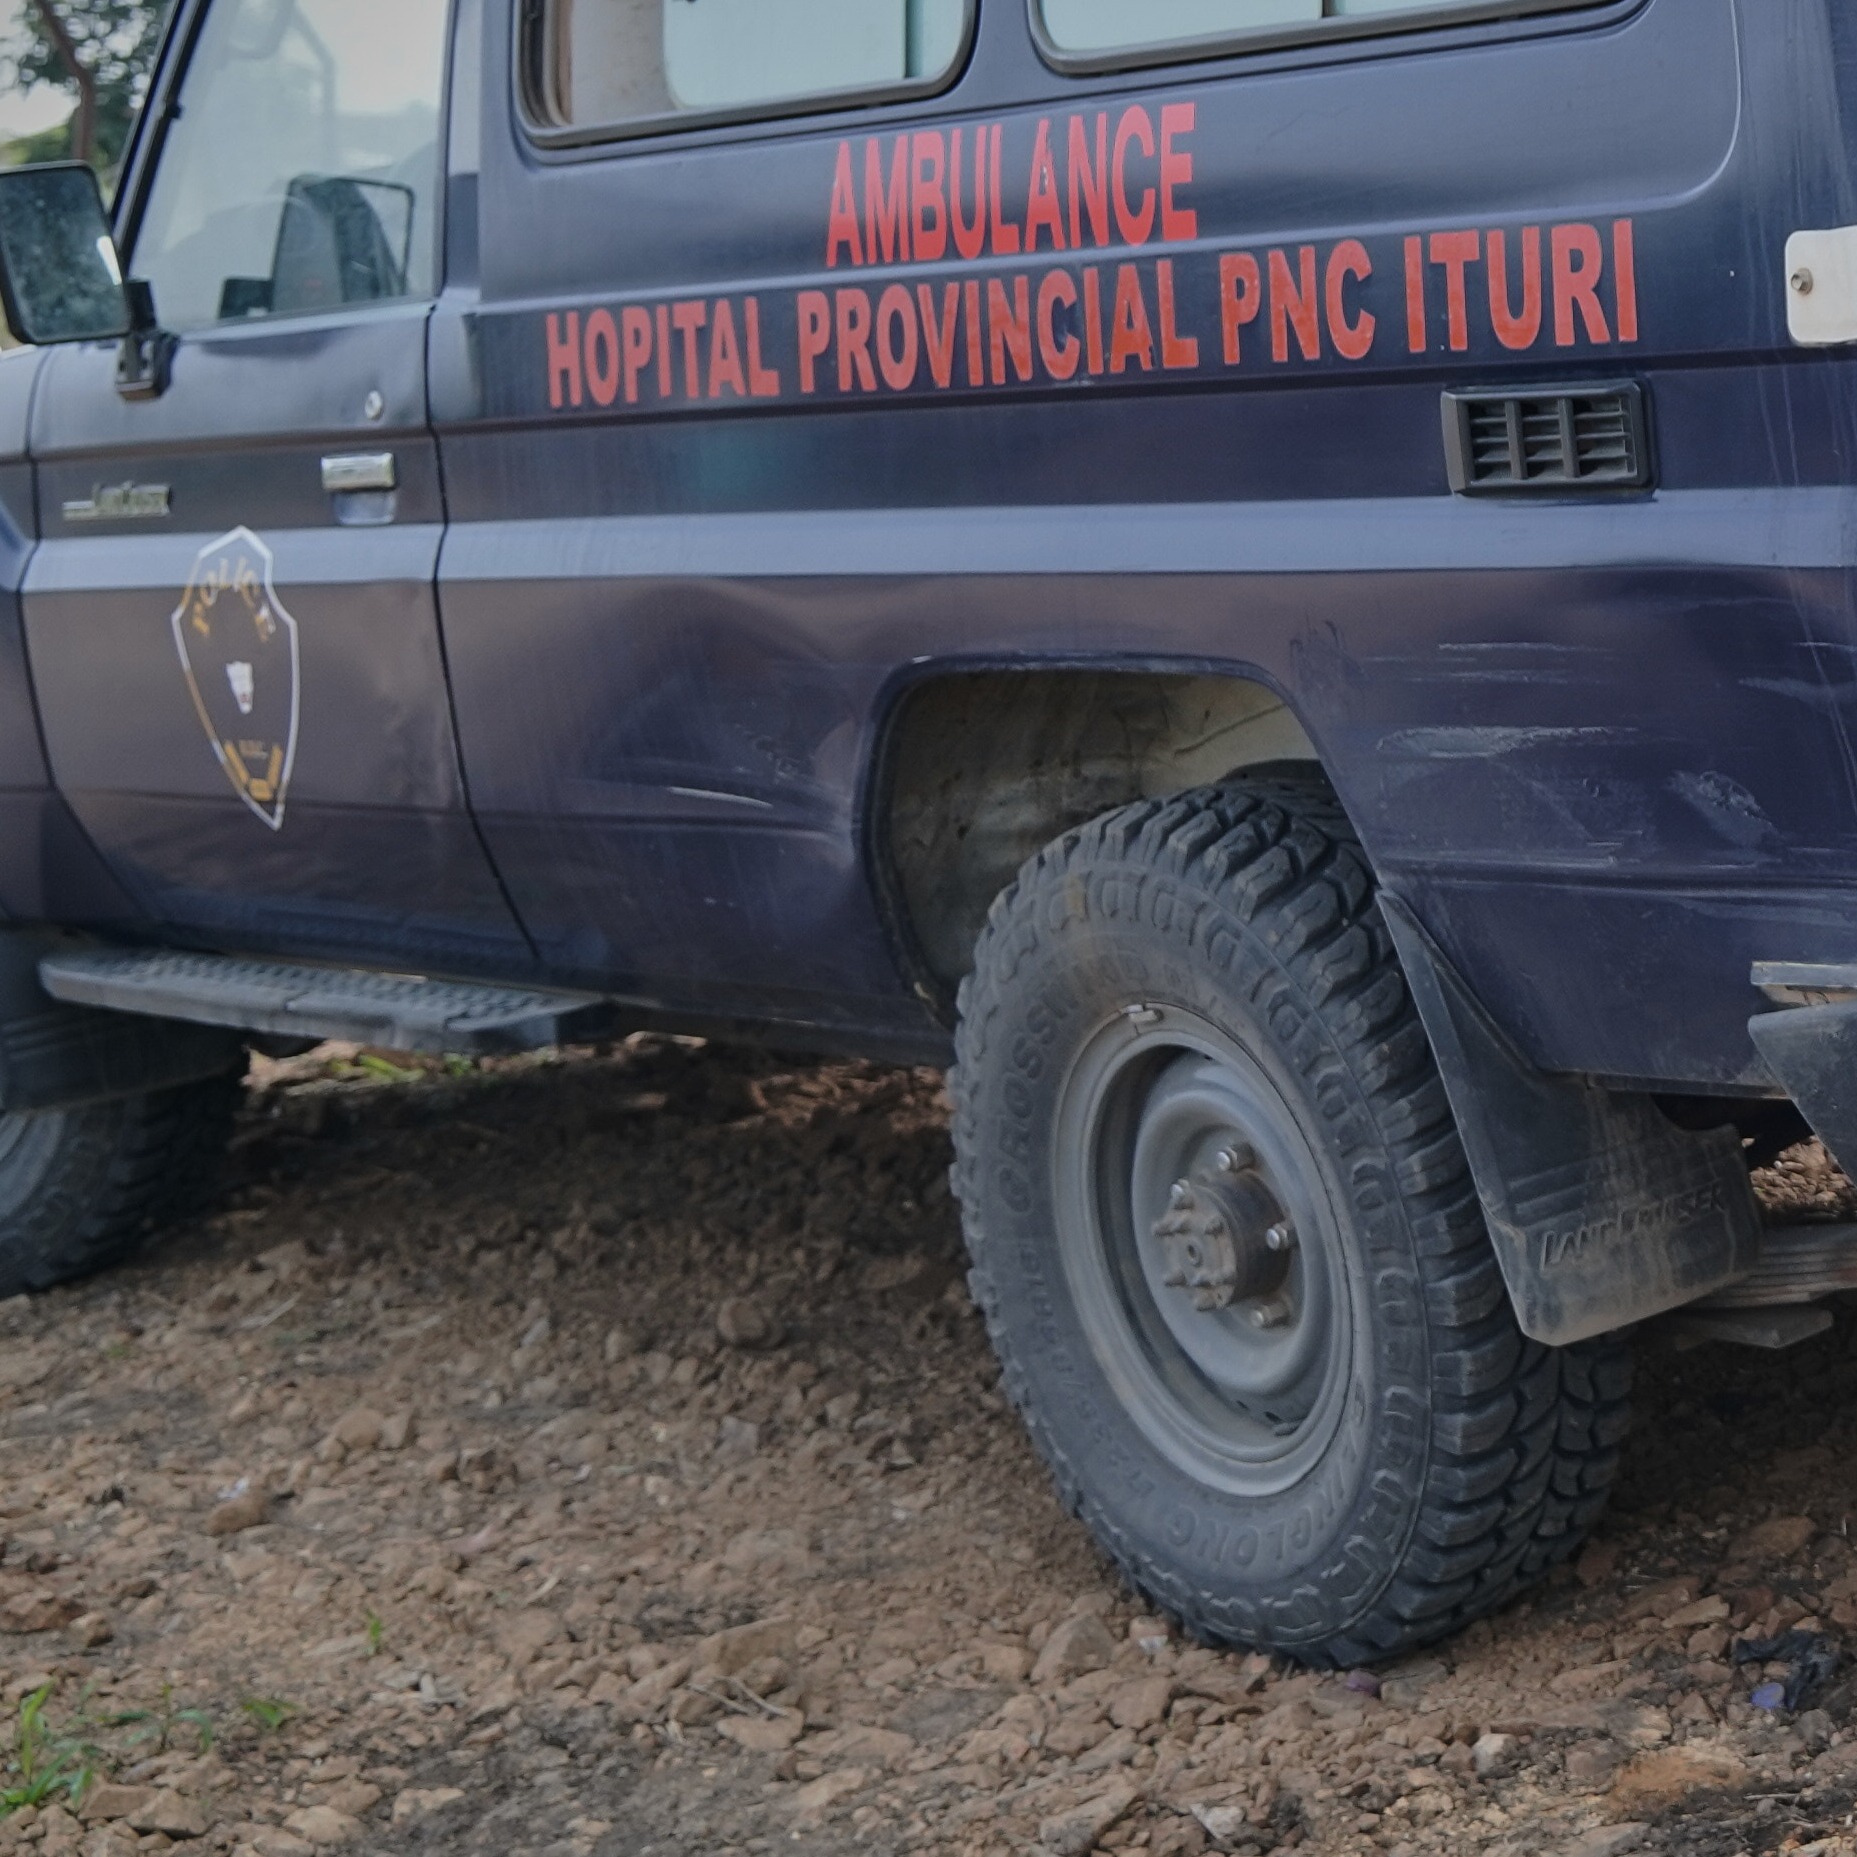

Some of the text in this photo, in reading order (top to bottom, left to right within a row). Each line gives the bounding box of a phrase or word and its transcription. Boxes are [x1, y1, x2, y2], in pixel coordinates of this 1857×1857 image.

[825, 102, 1199, 268] AMBULANCE
[545, 218, 1639, 408] HOPITAL PROVINCIAL PNC ITURI
